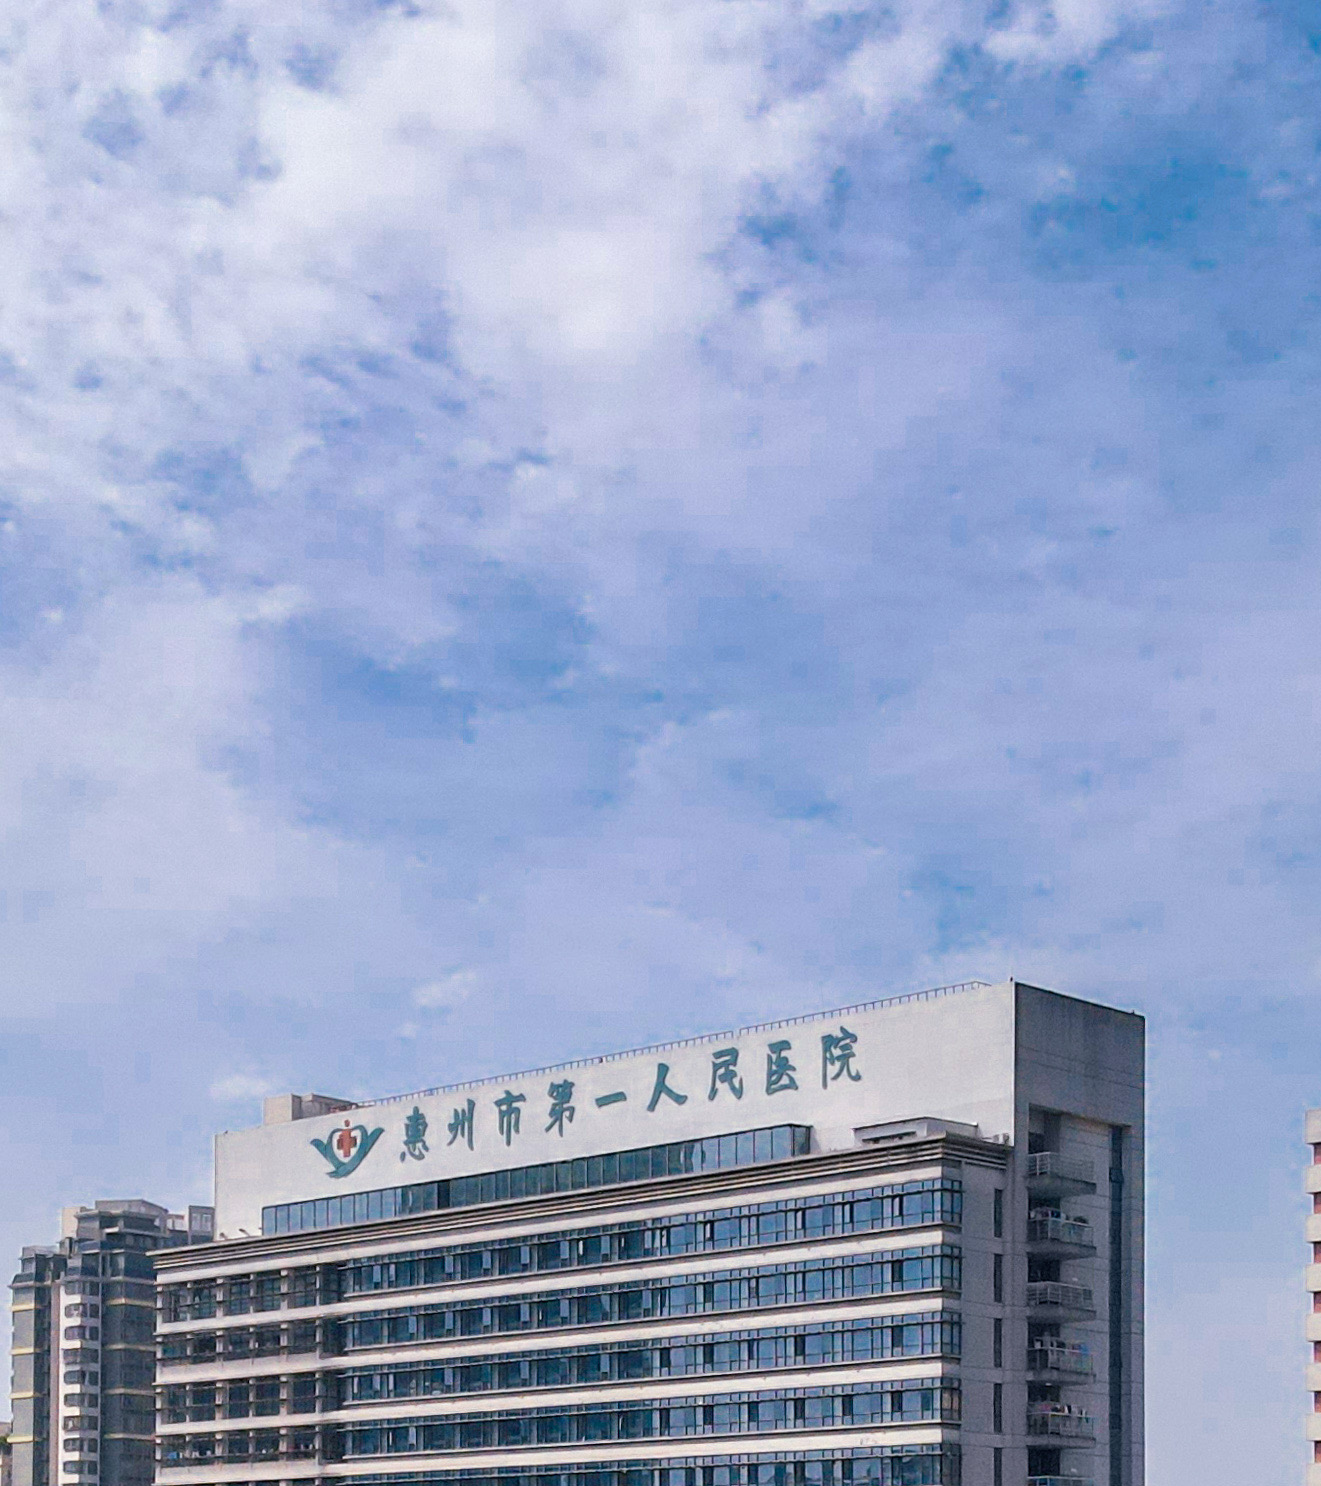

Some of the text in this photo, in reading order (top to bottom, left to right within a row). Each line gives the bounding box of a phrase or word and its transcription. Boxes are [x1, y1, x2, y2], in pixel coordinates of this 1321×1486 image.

[399, 1026, 862, 1161] 惠州市第一人民医院
